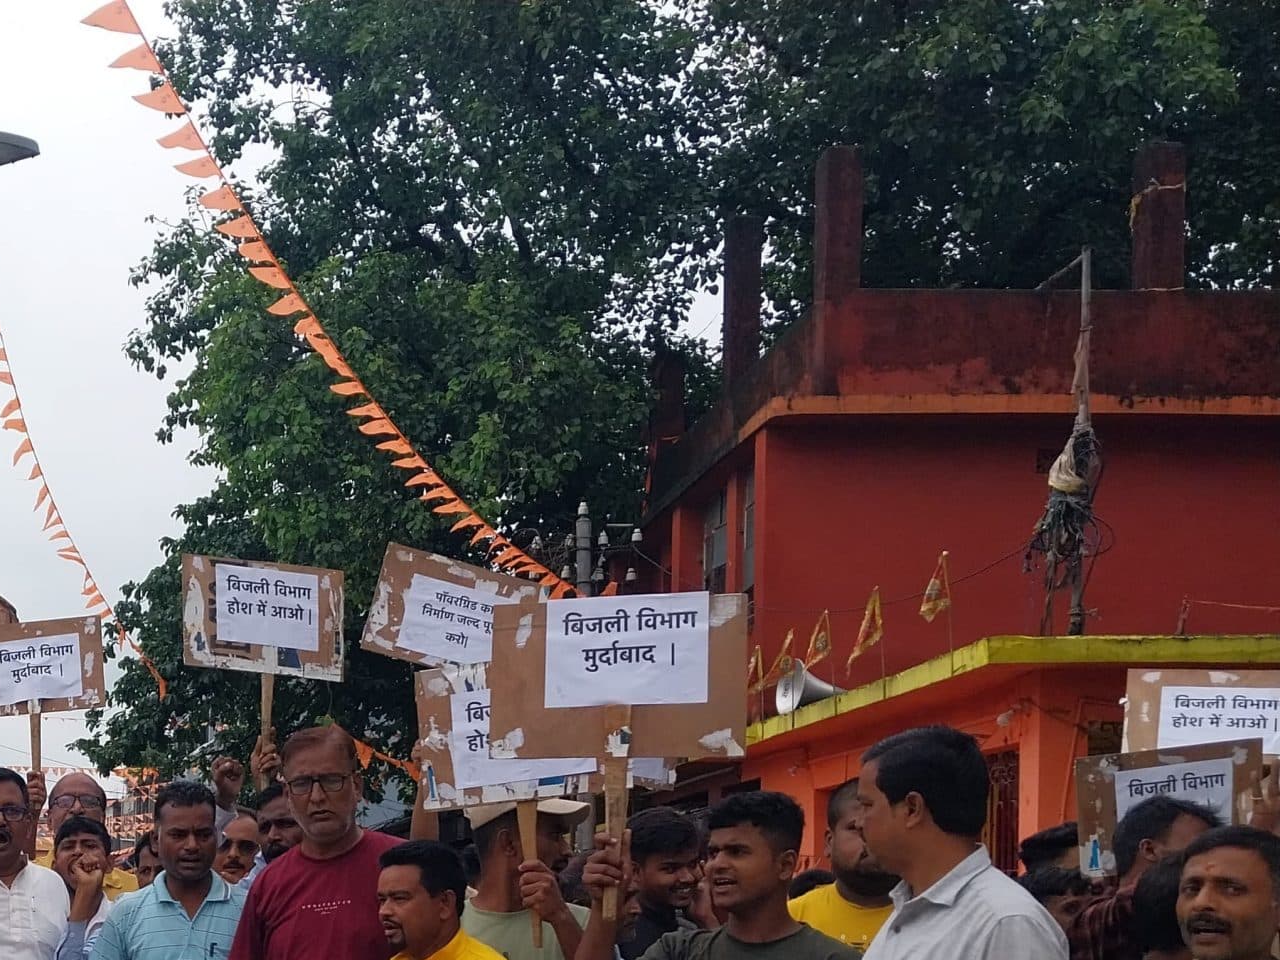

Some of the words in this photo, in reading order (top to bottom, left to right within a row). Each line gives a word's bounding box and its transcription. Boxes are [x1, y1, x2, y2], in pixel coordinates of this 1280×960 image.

[226, 574, 270, 595] बिजली
[274, 580, 312, 600] विभाग
[226, 597, 253, 615] होश
[256, 600, 268, 617] में
[271, 604, 304, 621] आओ
[422, 603, 455, 622] निर्माण
[456, 614, 481, 629] जल्द
[562, 609, 630, 635] बिजली
[636, 607, 698, 631] विभाग
[40, 644, 74, 657] विभाग
[581, 640, 657, 672] मुर्दाबाद
[11, 663, 52, 683] मुर्दाबाद
[1174, 694, 1225, 710] बिजली
[1232, 695, 1279, 710] विभाग
[1172, 713, 1202, 728] होश
[1207, 714, 1221, 727] में
[1226, 714, 1268, 729] आओ
[1129, 776, 1177, 798] बिजली
[1181, 772, 1226, 791] विभाग
